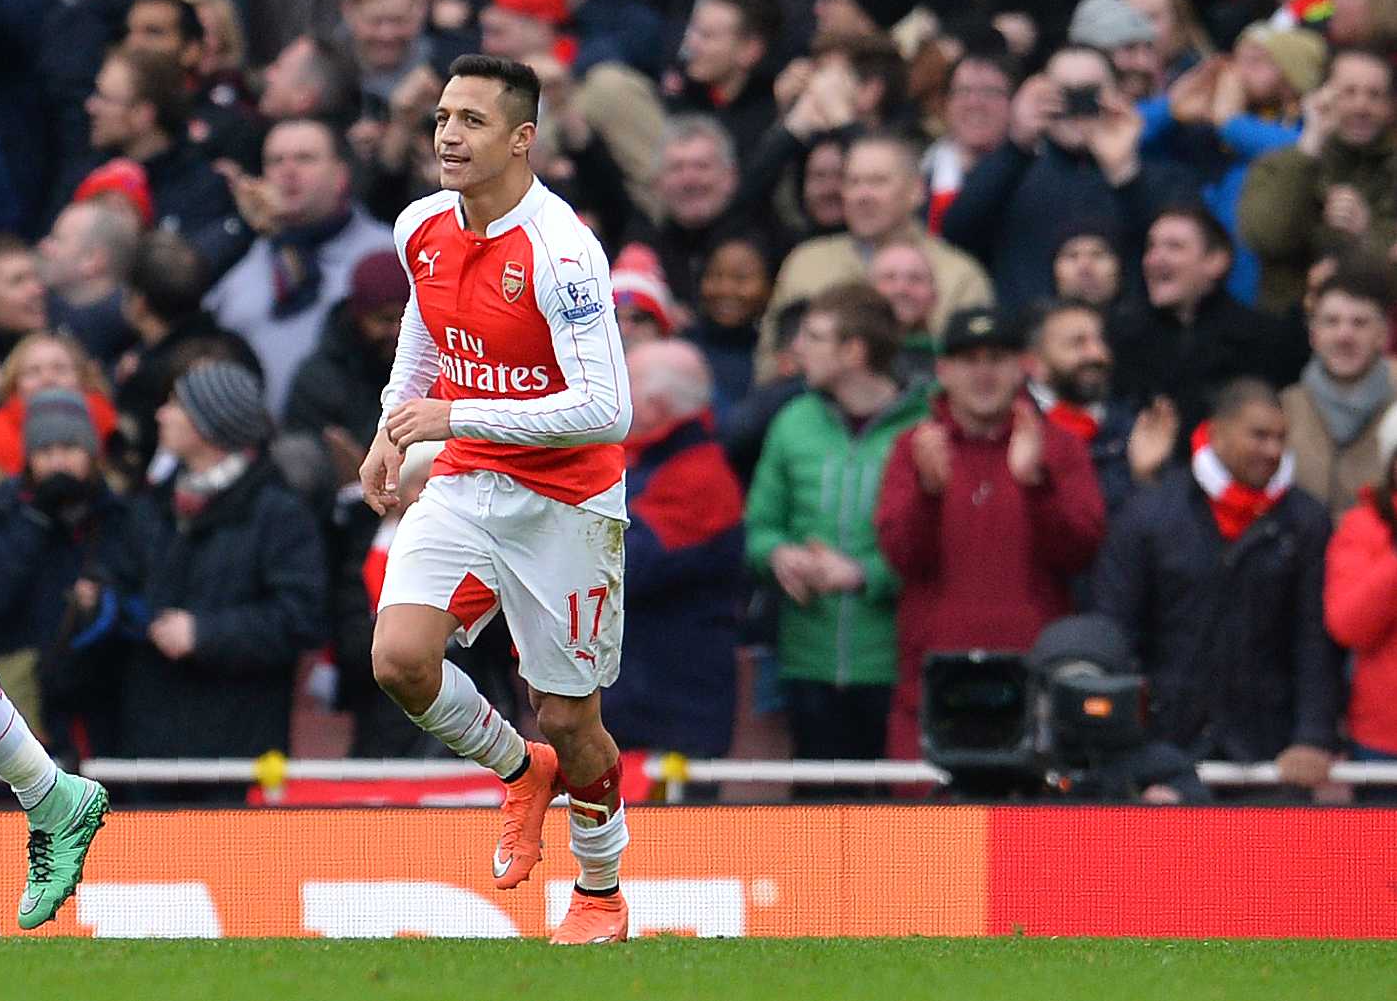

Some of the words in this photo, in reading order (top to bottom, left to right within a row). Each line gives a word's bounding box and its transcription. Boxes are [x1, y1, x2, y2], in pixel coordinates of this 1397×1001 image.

[445, 326, 484, 358] Fly
[438, 351, 549, 393] mirates
[566, 585, 608, 647] 17
